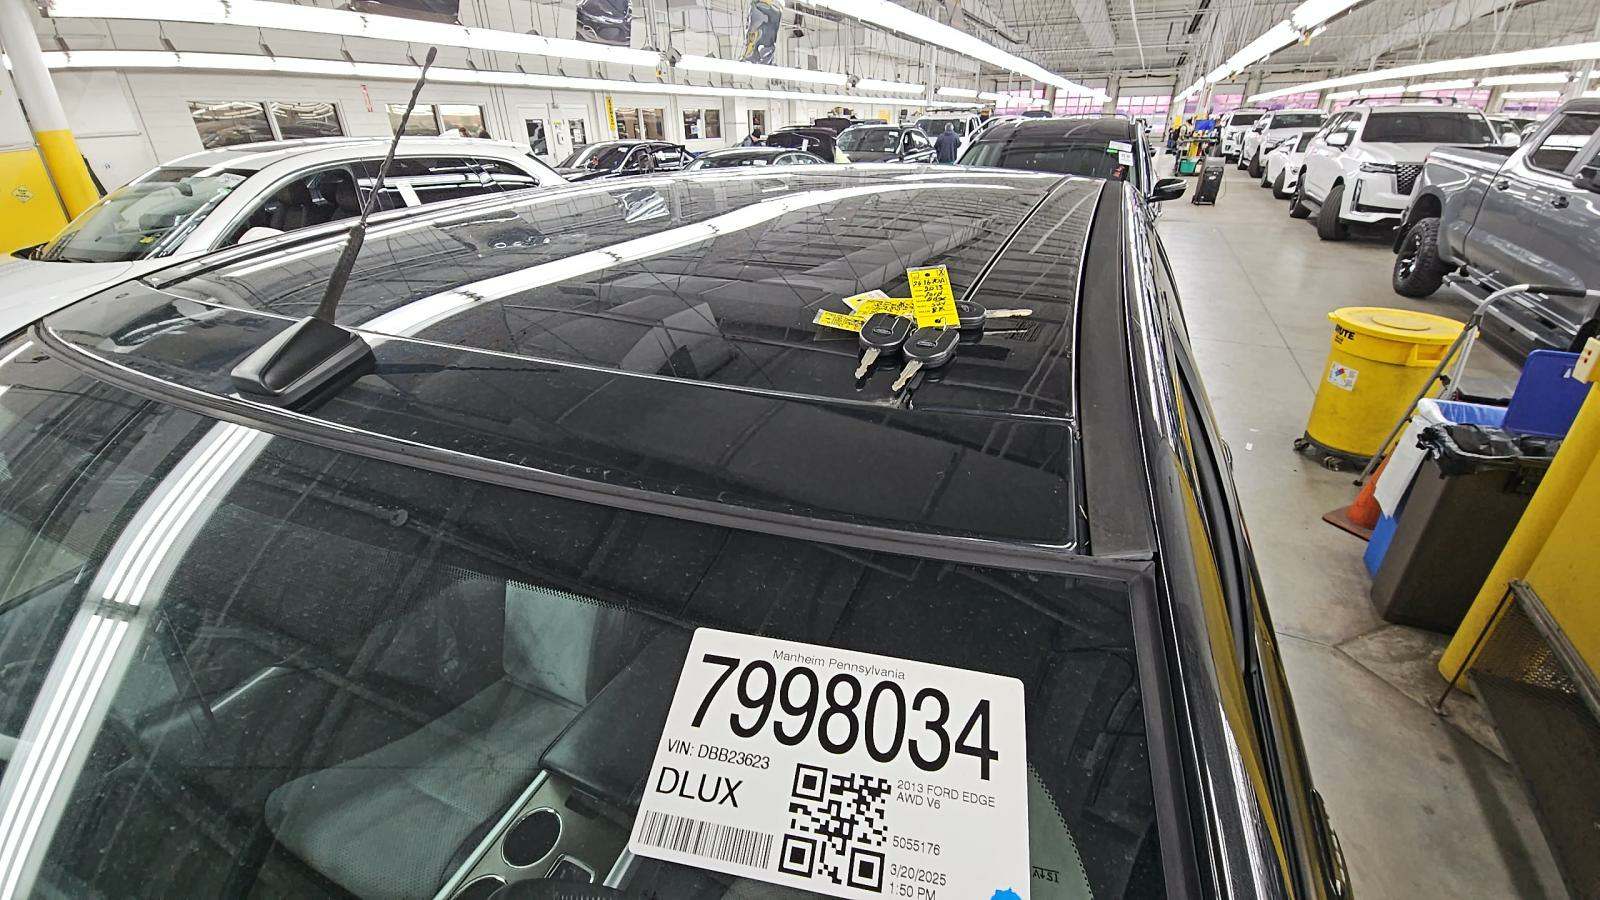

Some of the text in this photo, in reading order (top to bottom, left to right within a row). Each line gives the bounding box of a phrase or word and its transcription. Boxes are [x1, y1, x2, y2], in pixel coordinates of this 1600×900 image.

[772, 649, 905, 680] Manheim Pennsylvania
[690, 653, 999, 781] 7998034
[668, 738, 770, 770] VIN: DBB23623
[655, 766, 743, 808] DLUX
[896, 792, 941, 810] AWD V6
[897, 779, 996, 808] 2013 FORD EDGE
[892, 835, 941, 856] 5055176
[890, 863, 947, 886] 3/20/2025
[889, 882, 936, 900] 1:50 PM
